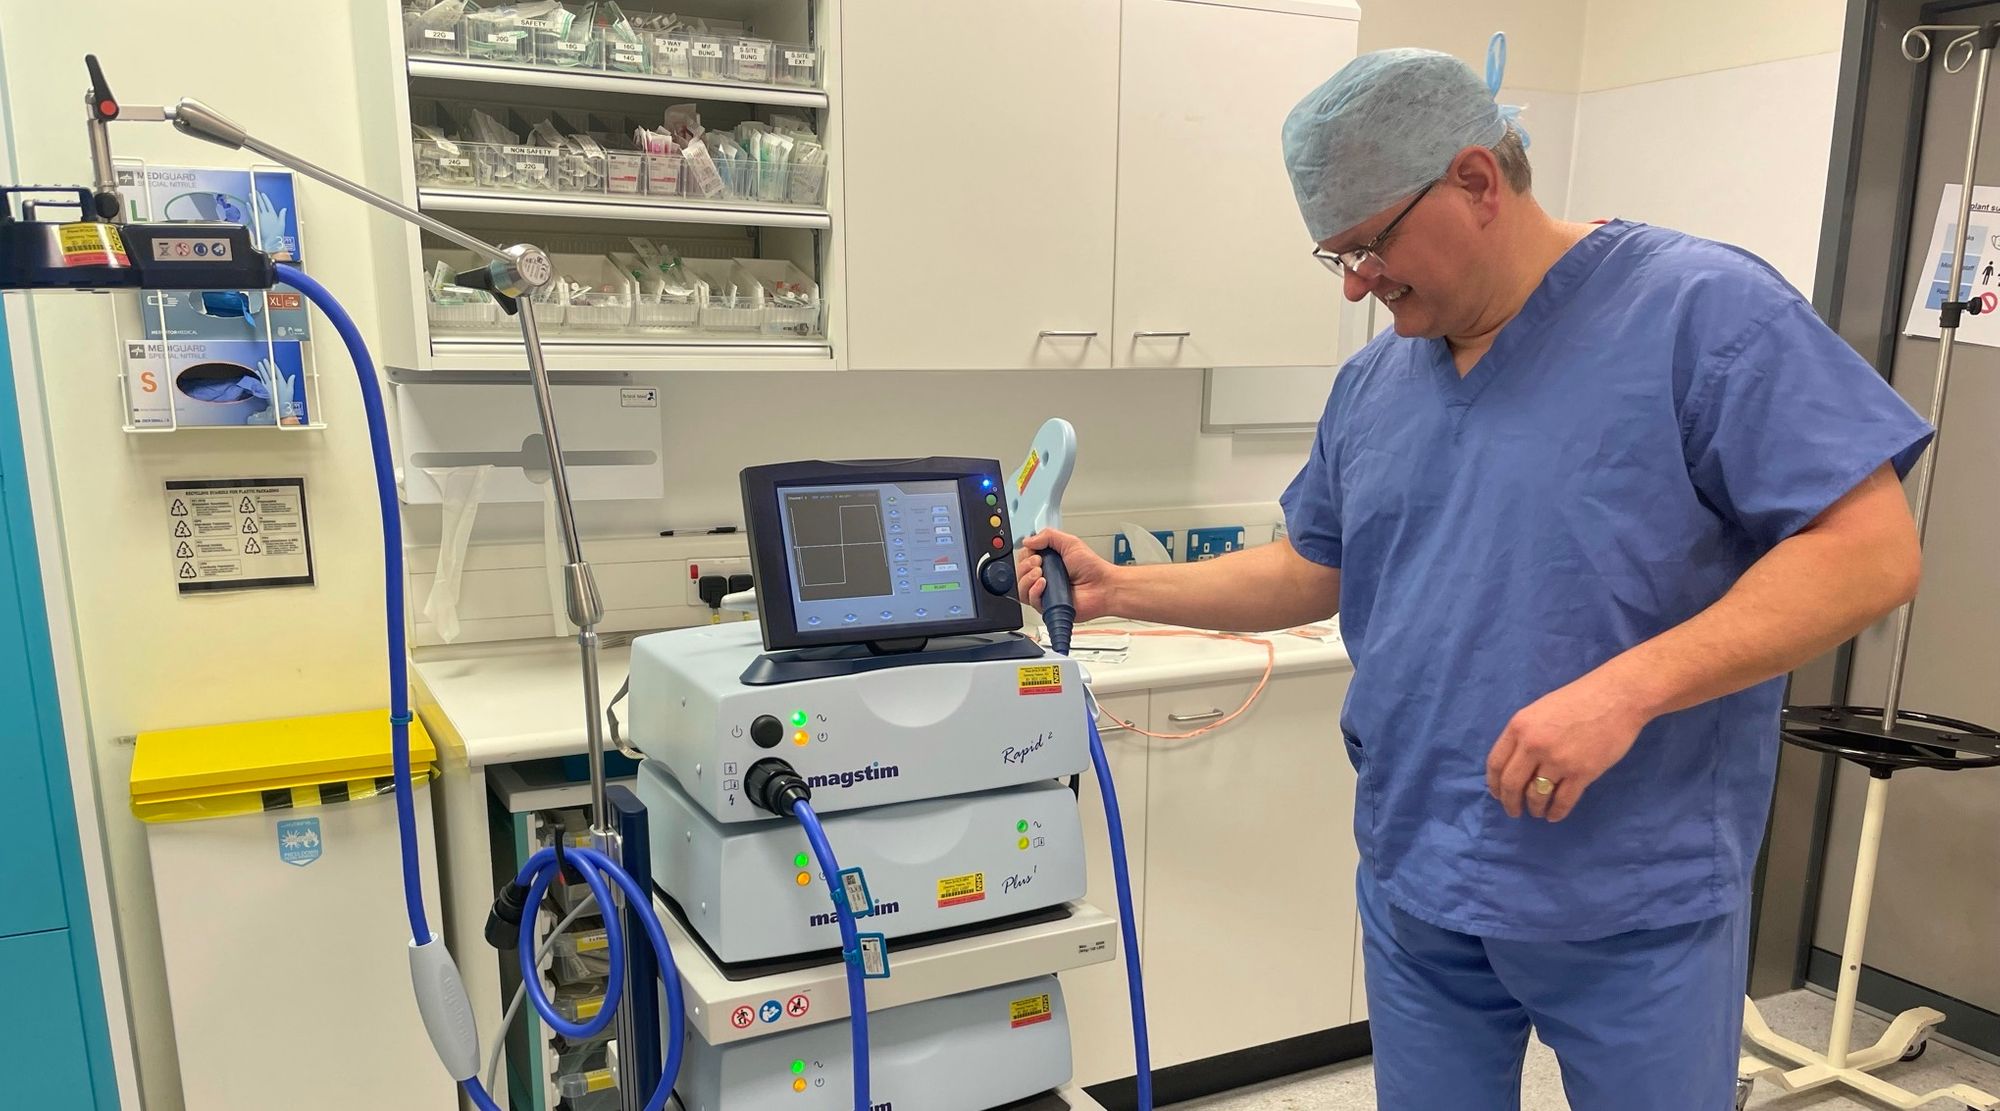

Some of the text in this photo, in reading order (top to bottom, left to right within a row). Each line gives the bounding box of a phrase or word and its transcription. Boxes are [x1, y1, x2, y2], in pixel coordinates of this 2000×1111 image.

[520, 19, 548, 28] SAFETY
[527, 147, 551, 155] SAFETY
[130, 200, 147, 221] L
[269, 297, 281, 307] XL
[148, 344, 206, 352] MEIGUARD
[141, 372, 157, 392] S
[1052, 665, 1060, 684] NHS
[1002, 731, 1052, 763] Rapid 2
[808, 761, 899, 788] magstim
[975, 873, 983, 891] NHS
[1001, 874, 1032, 893] Plus
[810, 899, 899, 927] maim
